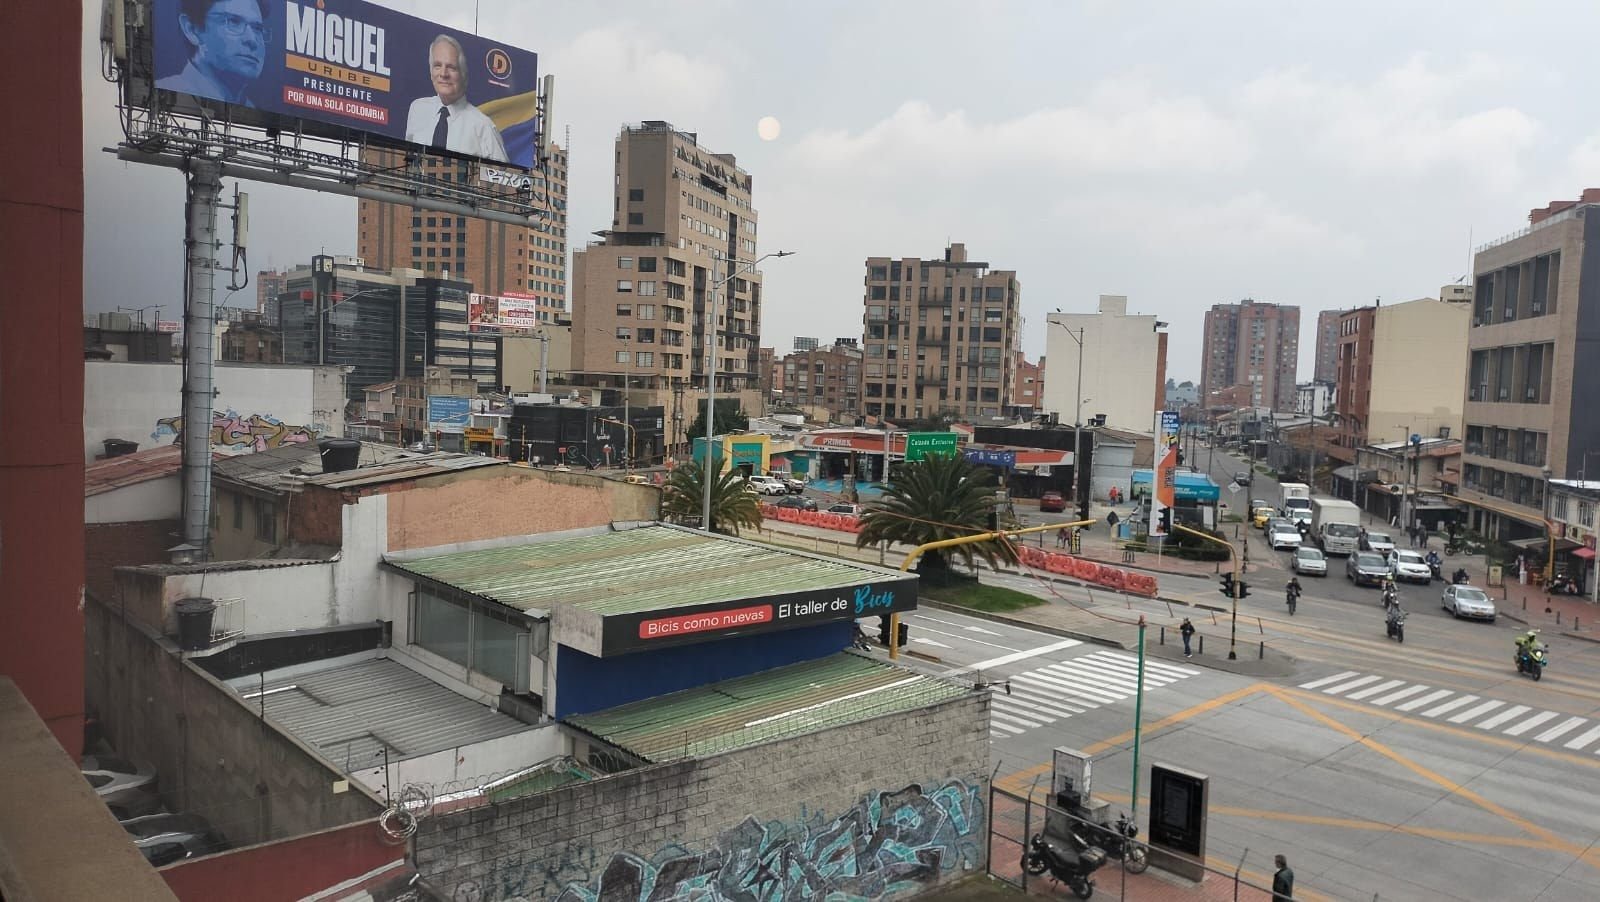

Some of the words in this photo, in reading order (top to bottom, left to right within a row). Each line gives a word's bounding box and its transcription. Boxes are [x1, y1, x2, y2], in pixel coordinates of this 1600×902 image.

[286, 0, 390, 76] MIGUEL
[308, 61, 371, 85] URIBE
[303, 77, 373, 101] PRESIDENTE
[288, 90, 304, 102] POR
[306, 95, 322, 107] UNA
[324, 98, 343, 112] SOLA
[346, 103, 384, 120] COLOMBIA
[778, 604, 791, 618] El
[794, 600, 828, 616] taller
[830, 597, 848, 611] de
[854, 585, 895, 613] Bicis
[648, 621, 679, 634] Bicis
[683, 617, 719, 630] como
[723, 610, 764, 625] nuevas
